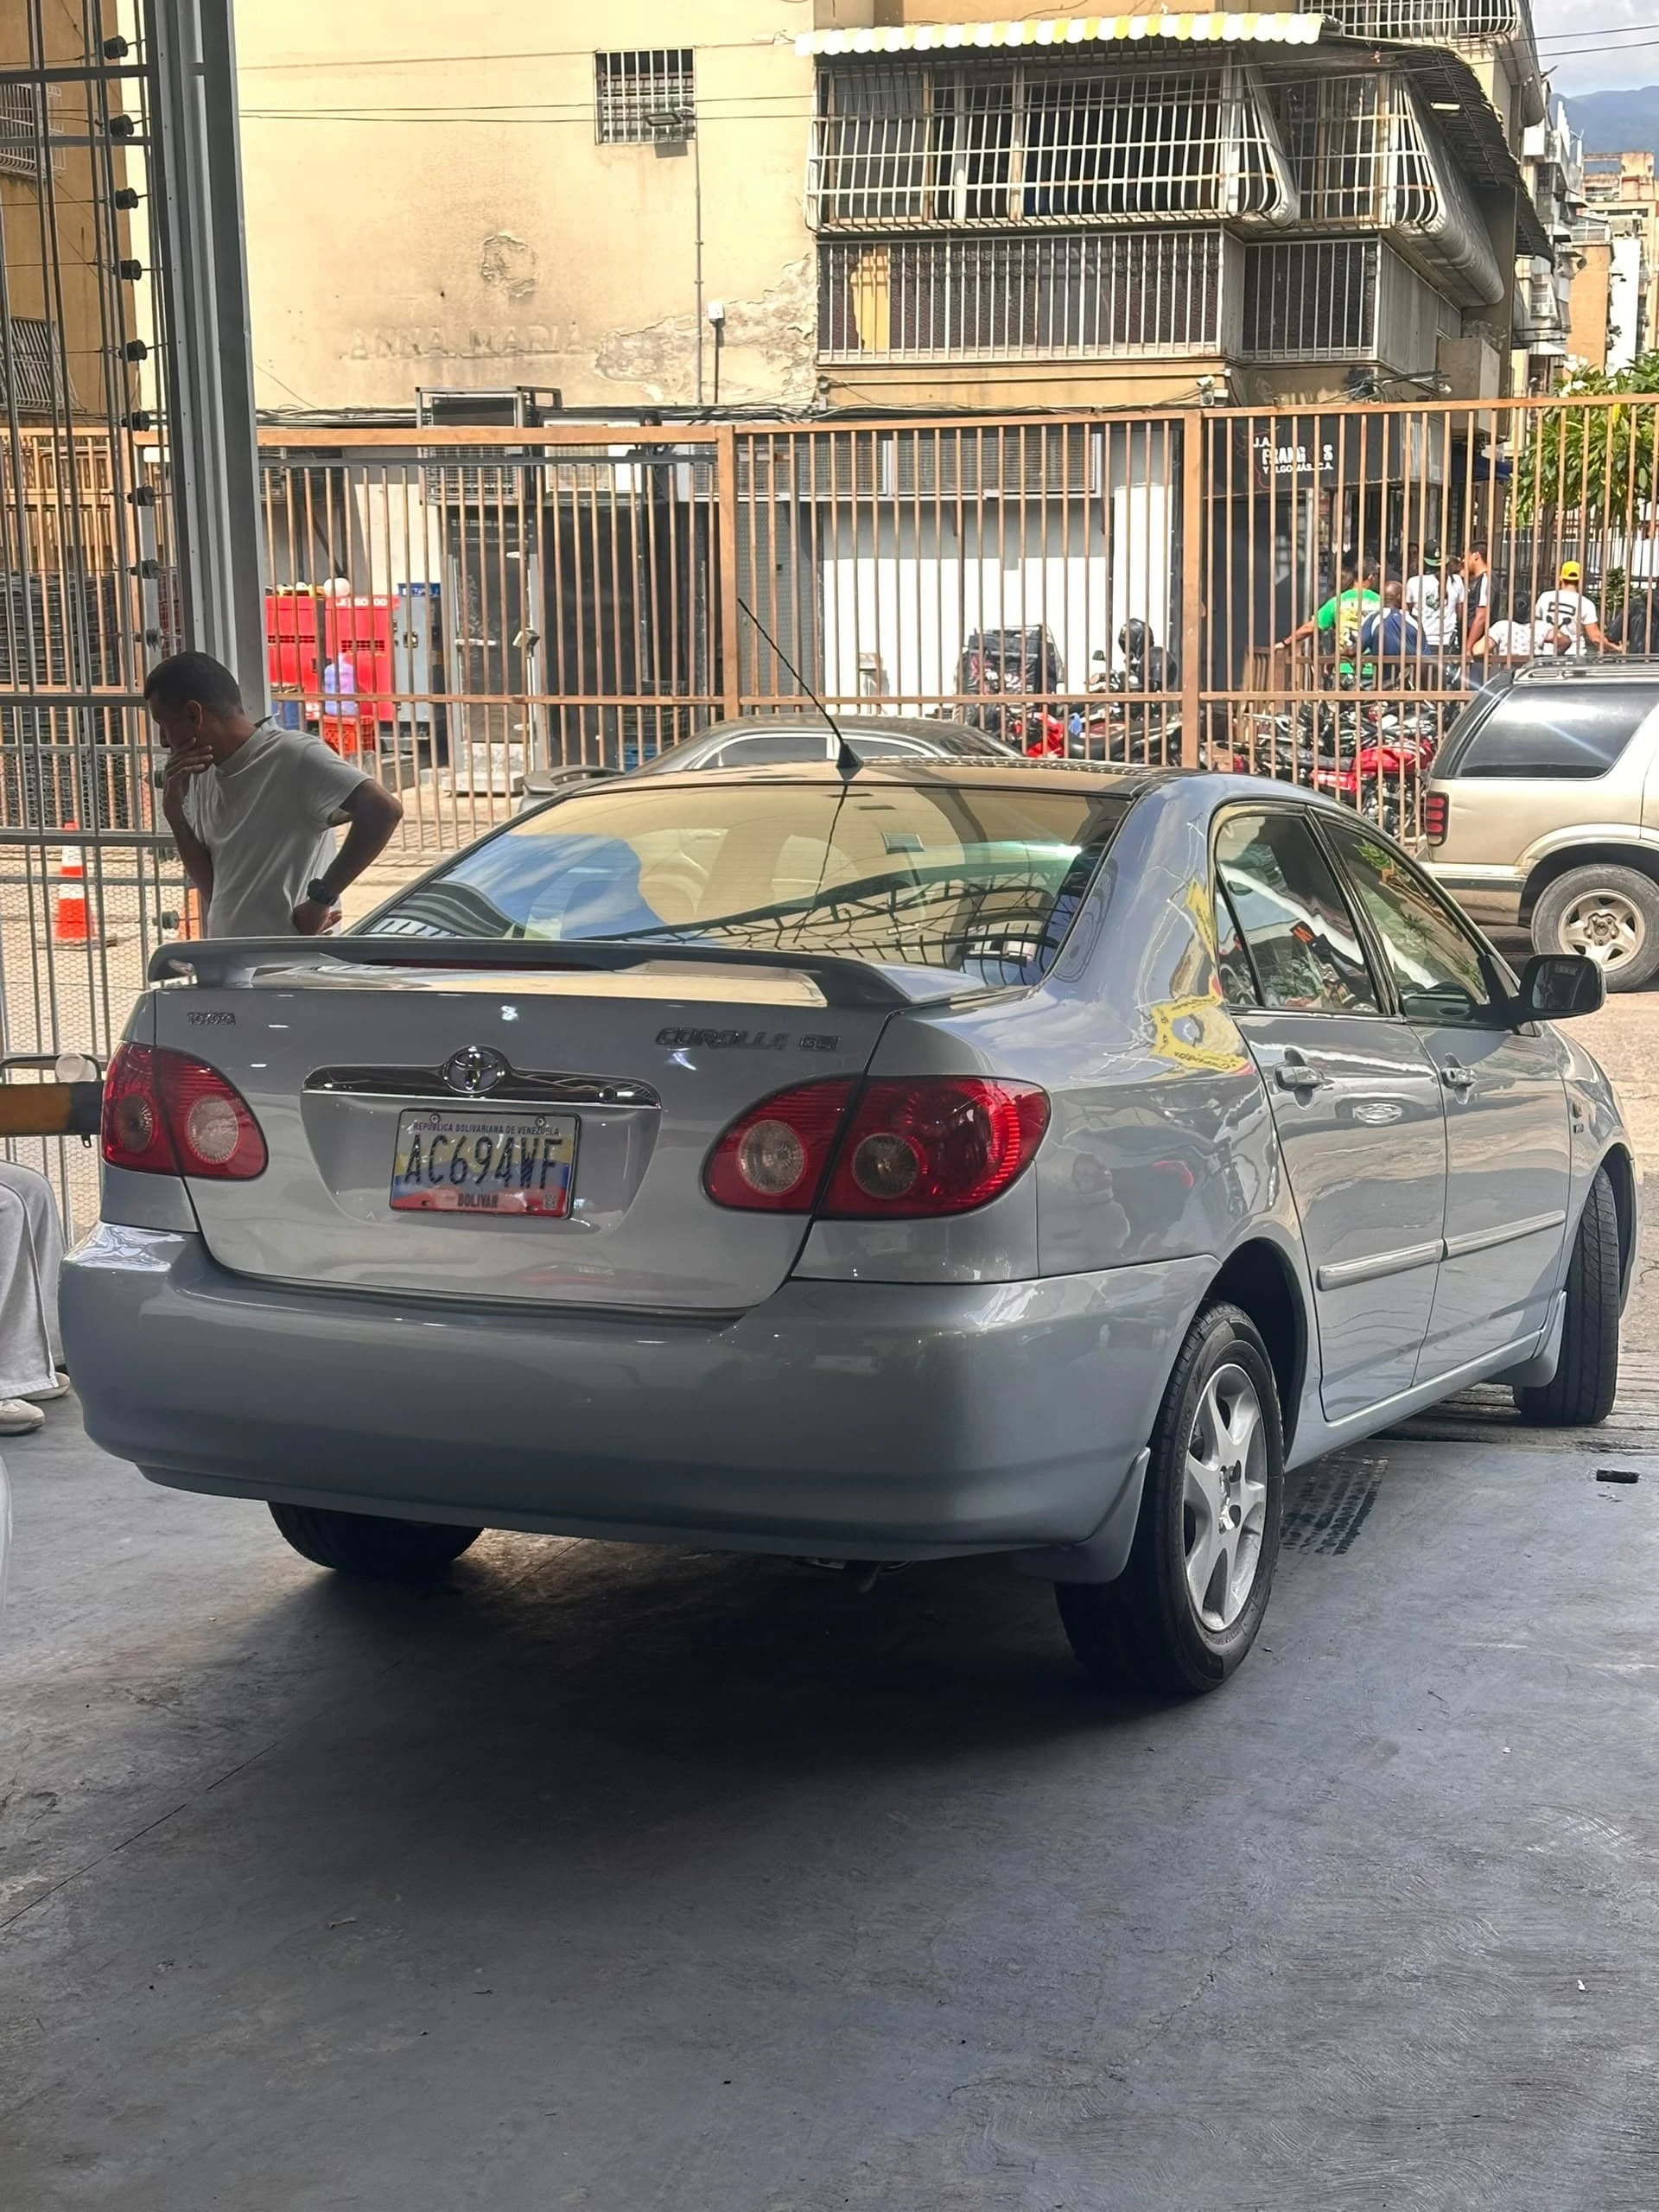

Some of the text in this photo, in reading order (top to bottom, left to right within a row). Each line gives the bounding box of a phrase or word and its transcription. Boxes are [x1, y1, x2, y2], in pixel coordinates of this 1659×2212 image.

[350, 323, 586, 359] ANNA MARIA
[1262, 444, 1333, 465] FRANGS
[1269, 465, 1294, 474] LGO
[654, 1027, 790, 1051] COROLLA
[455, 1124, 504, 1135] BOLIVARIANA
[505, 1126, 515, 1135] DE
[518, 1126, 561, 1136] VENEZUELA
[404, 1134, 563, 1190] AC694WF
